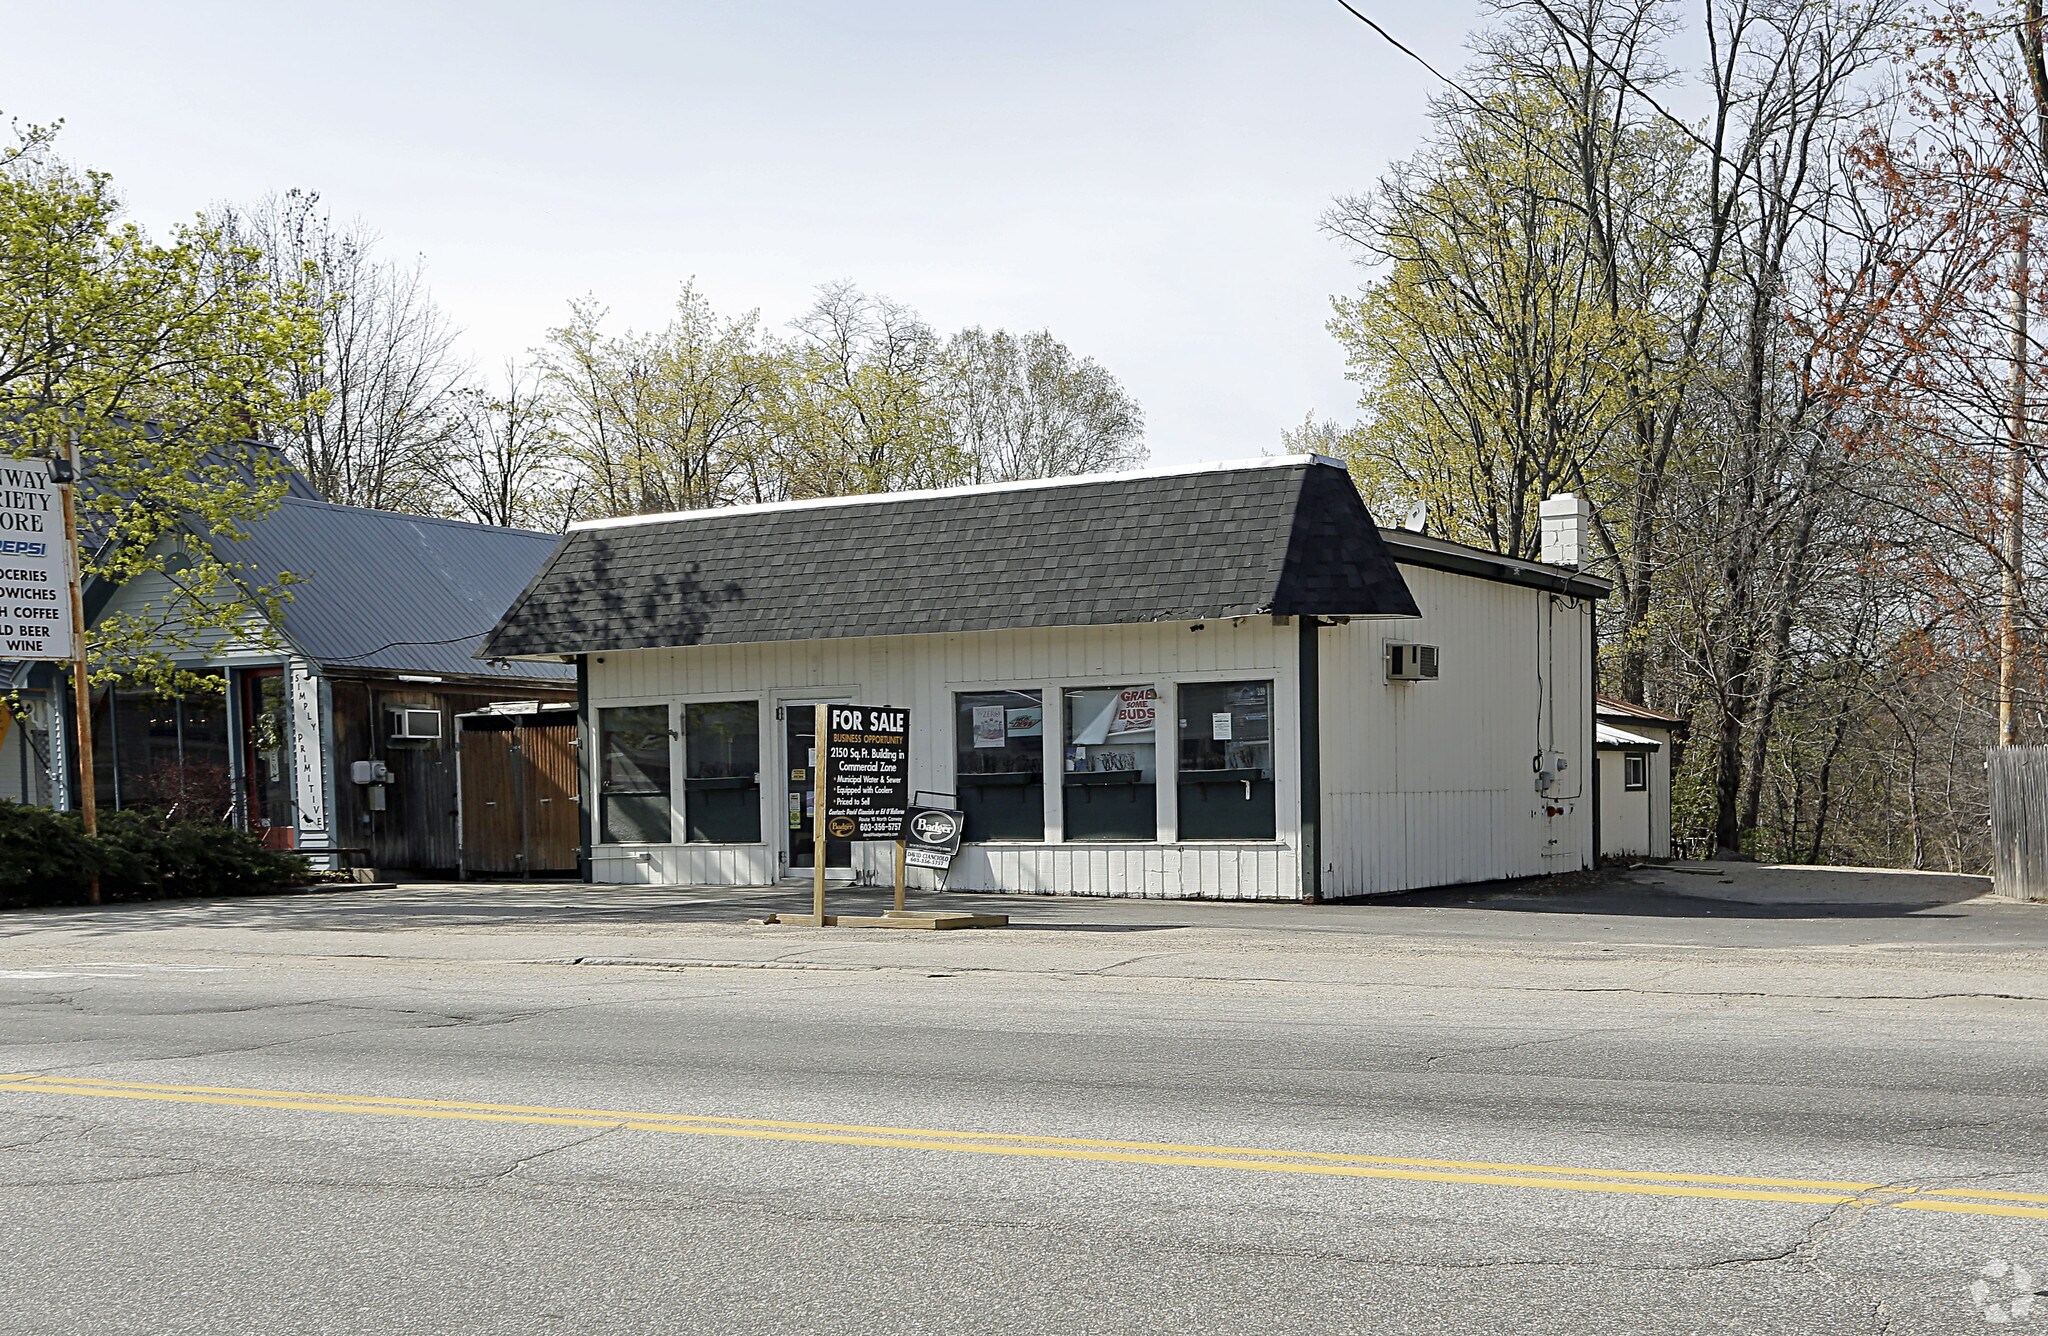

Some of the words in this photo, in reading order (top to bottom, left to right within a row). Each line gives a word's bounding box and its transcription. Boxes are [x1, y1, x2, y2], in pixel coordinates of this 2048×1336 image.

[0, 469, 48, 489] WAY
[0, 490, 51, 511] IETY
[0, 512, 43, 532] ORE
[0, 541, 46, 556] EPSI
[14, 607, 59, 619] COFFEE
[20, 625, 50, 637] BEER
[6, 640, 43, 651] WINE
[295, 674, 316, 731] SIMPLY
[1119, 708, 1155, 720] BUDS
[833, 710, 863, 730] FOR
[870, 712, 904, 732] SALE
[834, 734, 861, 743] BUSINESS
[864, 735, 903, 744] OPPORTUNITY
[830, 747, 849, 758] 2150
[871, 748, 897, 762] Building
[898, 749, 905, 759] in
[839, 761, 878, 771] Commercial
[879, 761, 897, 772] Zone
[297, 733, 322, 826] PRIMITIVE
[837, 775, 861, 784] Municipal
[862, 775, 879, 784] Water
[879, 775, 885, 784] &
[886, 776, 901, 784] Sewer
[837, 786, 861, 795] Equipped
[862, 786, 874, 794] with
[874, 786, 893, 794] Coolers
[837, 797, 853, 805] Priced
[854, 798, 860, 806] to
[861, 797, 871, 806] Sell
[917, 818, 952, 833] Badger
